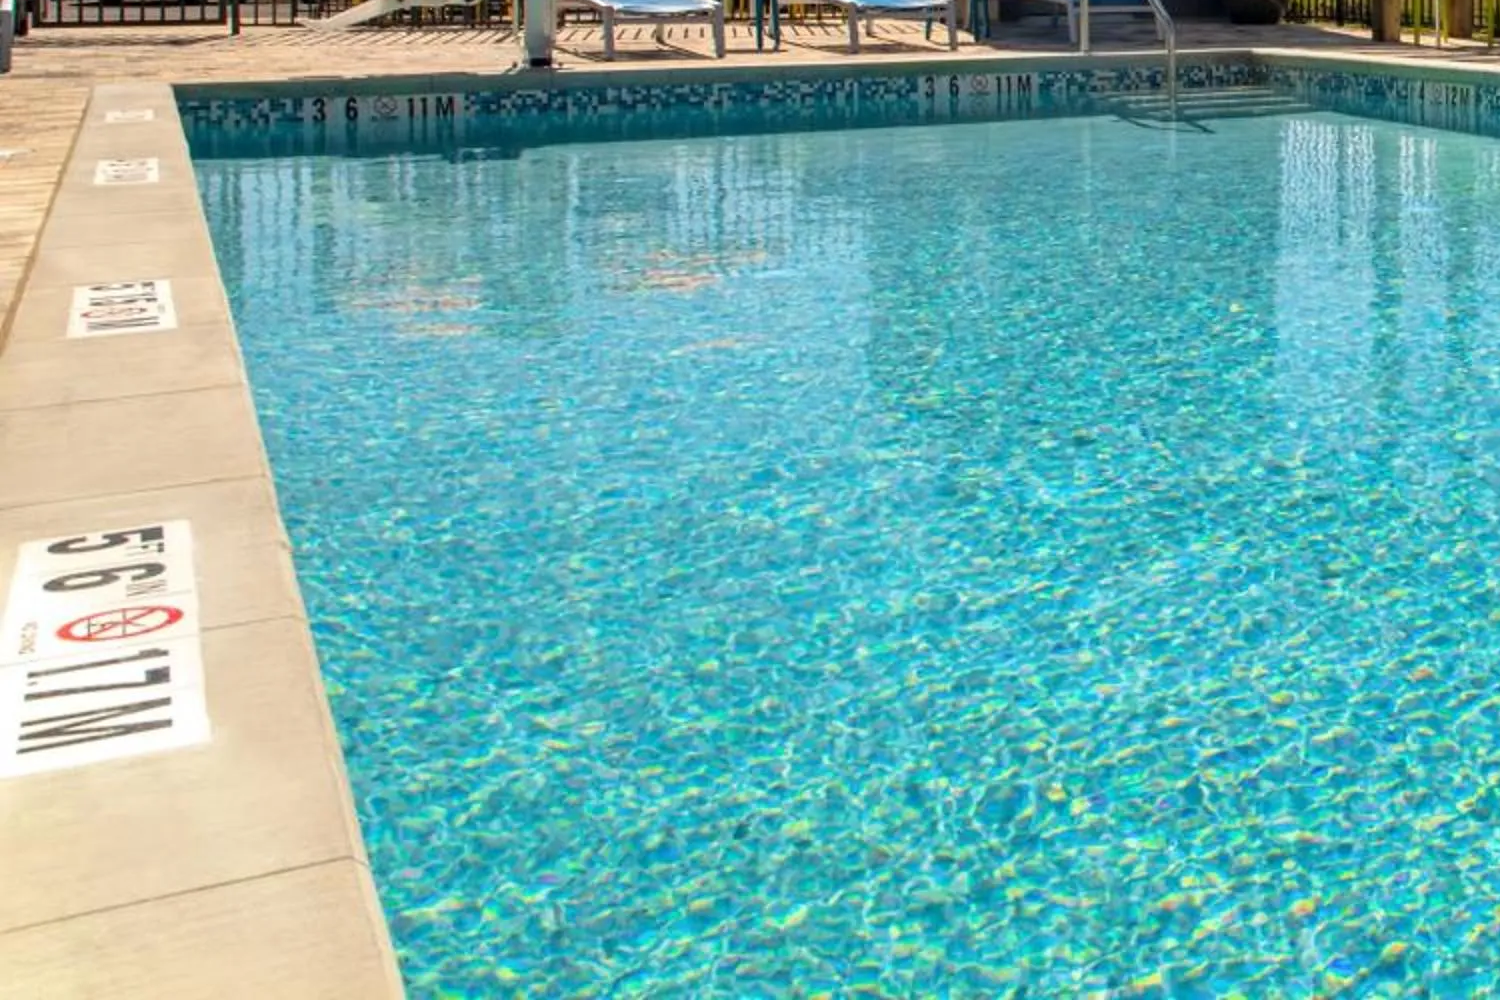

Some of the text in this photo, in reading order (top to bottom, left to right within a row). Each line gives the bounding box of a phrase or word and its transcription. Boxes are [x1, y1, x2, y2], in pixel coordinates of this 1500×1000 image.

[925, 76, 935, 98] 3
[949, 75, 959, 97] 6
[312, 98, 326, 121] 3
[345, 97, 358, 121] 6
[47, 526, 164, 555] 5
[43, 562, 166, 592] 6
